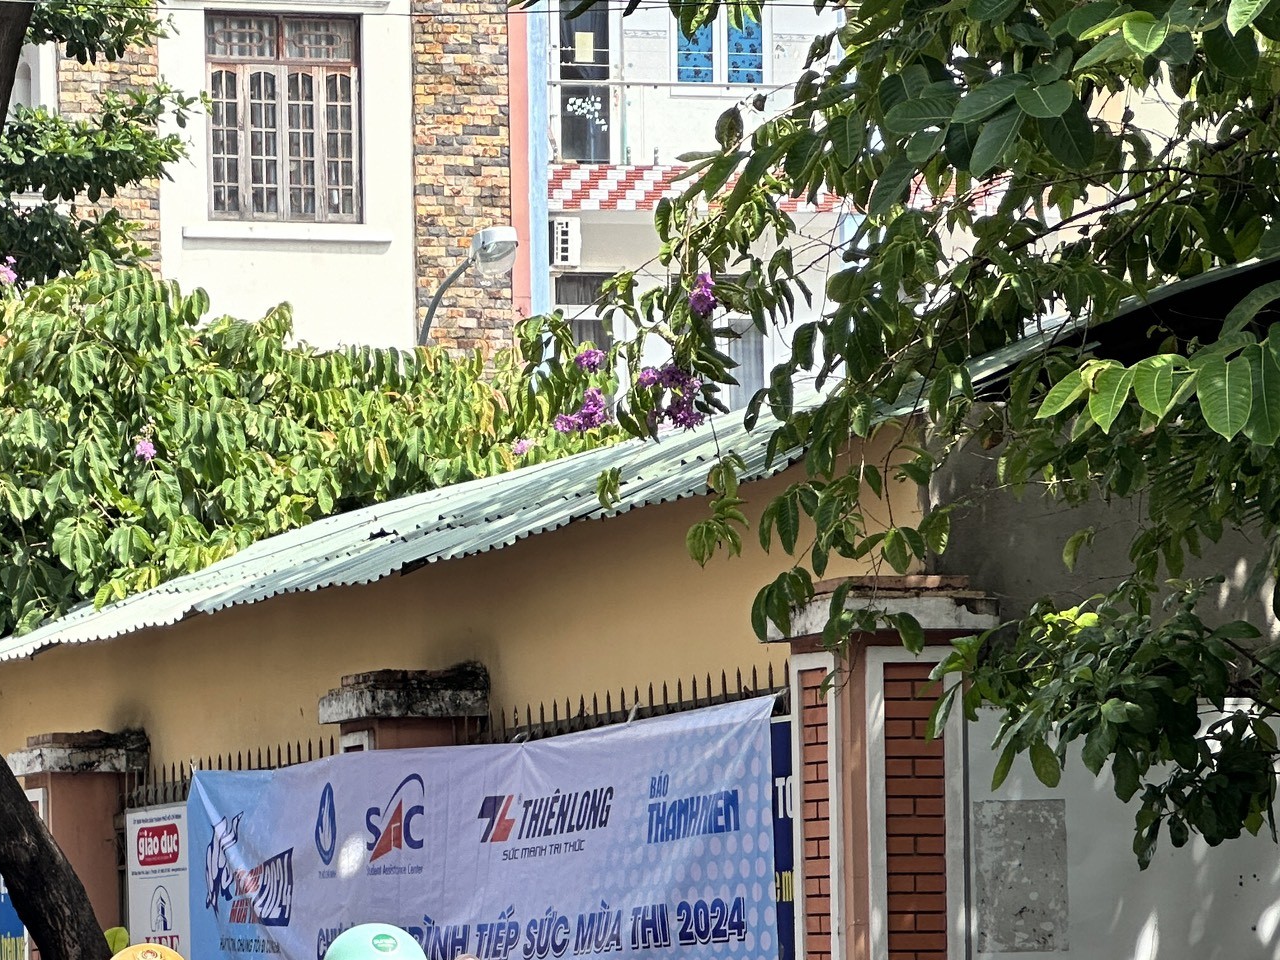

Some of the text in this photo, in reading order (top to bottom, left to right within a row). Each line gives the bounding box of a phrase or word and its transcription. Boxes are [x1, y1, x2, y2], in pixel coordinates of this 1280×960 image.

[649, 771, 669, 799] BÁO
[139, 830, 178, 860] giáo dục
[365, 798, 424, 863] SAC
[549, 842, 562, 856] TRI
[408, 864, 423, 874] Center
[254, 854, 291, 919] 2024
[523, 906, 570, 960] SỨC
[573, 899, 623, 955] MÙA
[630, 903, 672, 950] THI
[676, 896, 748, 943] 2024
